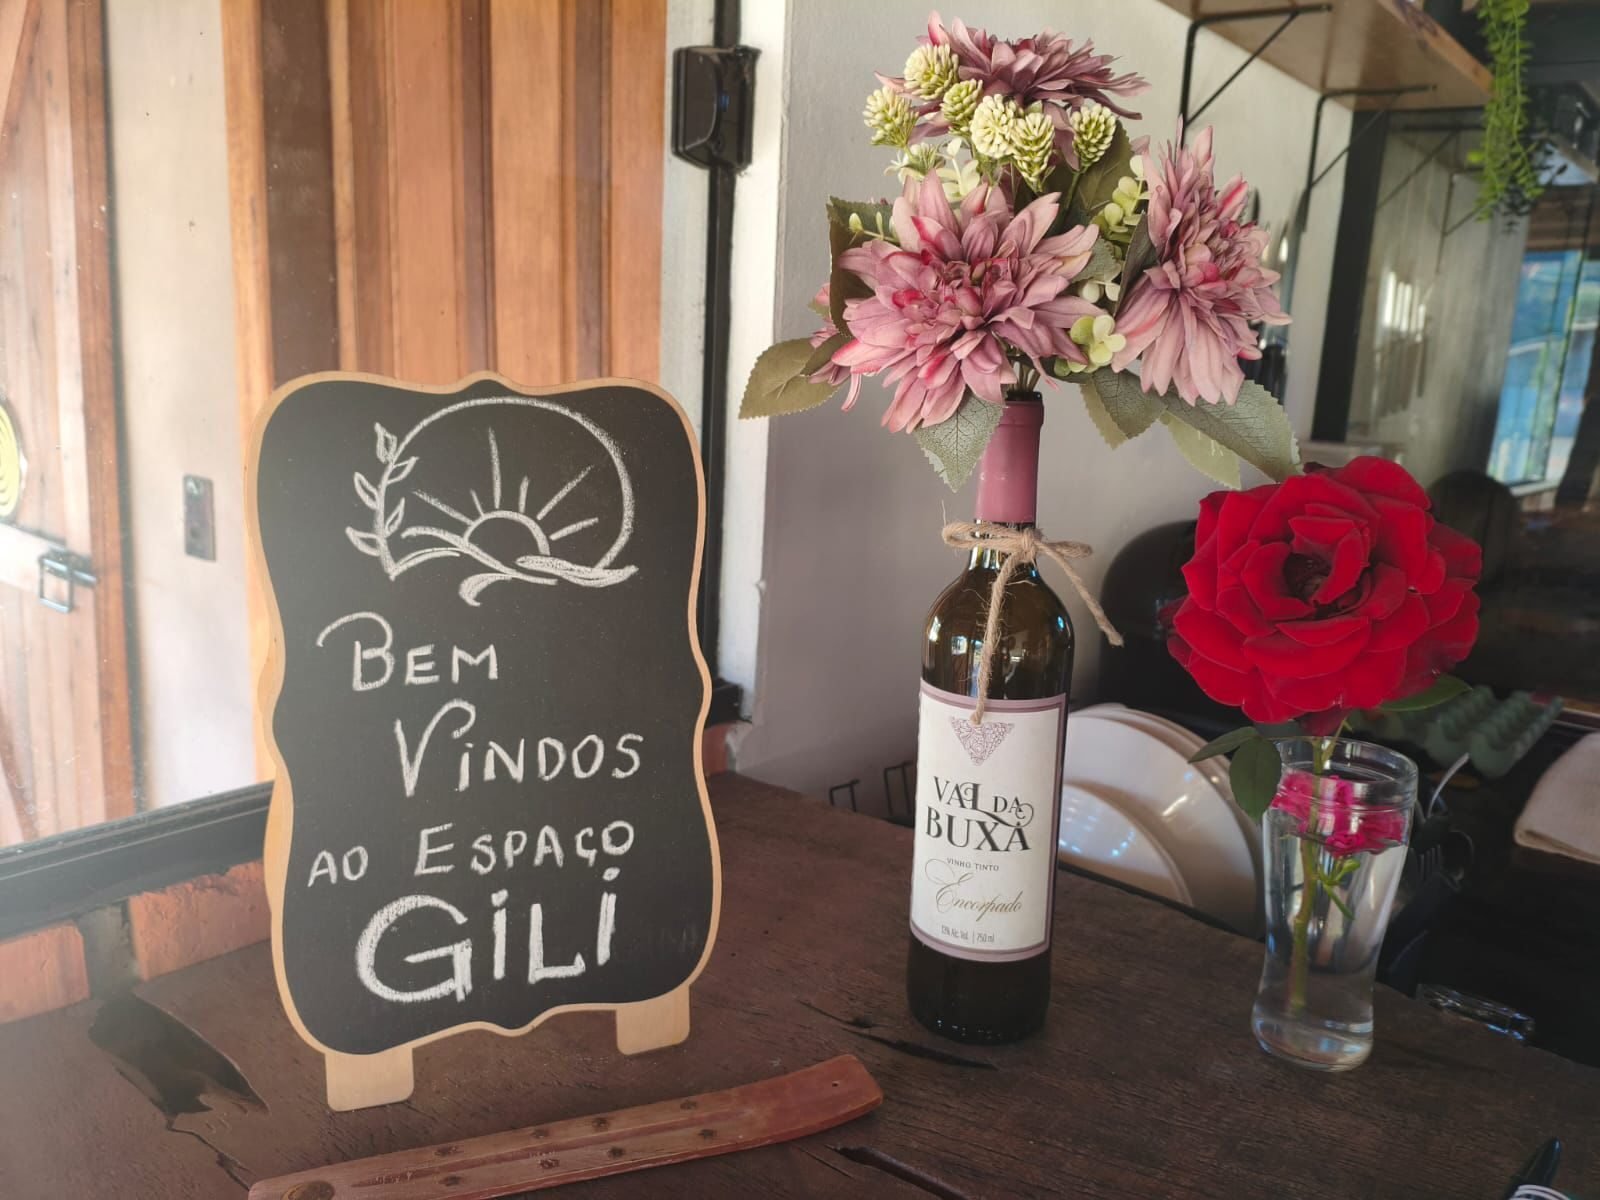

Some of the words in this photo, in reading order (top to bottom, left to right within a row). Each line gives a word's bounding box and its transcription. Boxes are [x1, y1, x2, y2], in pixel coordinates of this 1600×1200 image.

[316, 612, 498, 691] BEM
[926, 806, 1032, 852] BUXA
[993, 796, 1024, 814] DA
[308, 846, 369, 887] AO
[415, 820, 635, 876] ESPAÇO
[946, 857, 972, 869] VINHO
[975, 862, 1000, 872] TINTO
[925, 858, 1024, 922] Encorpado
